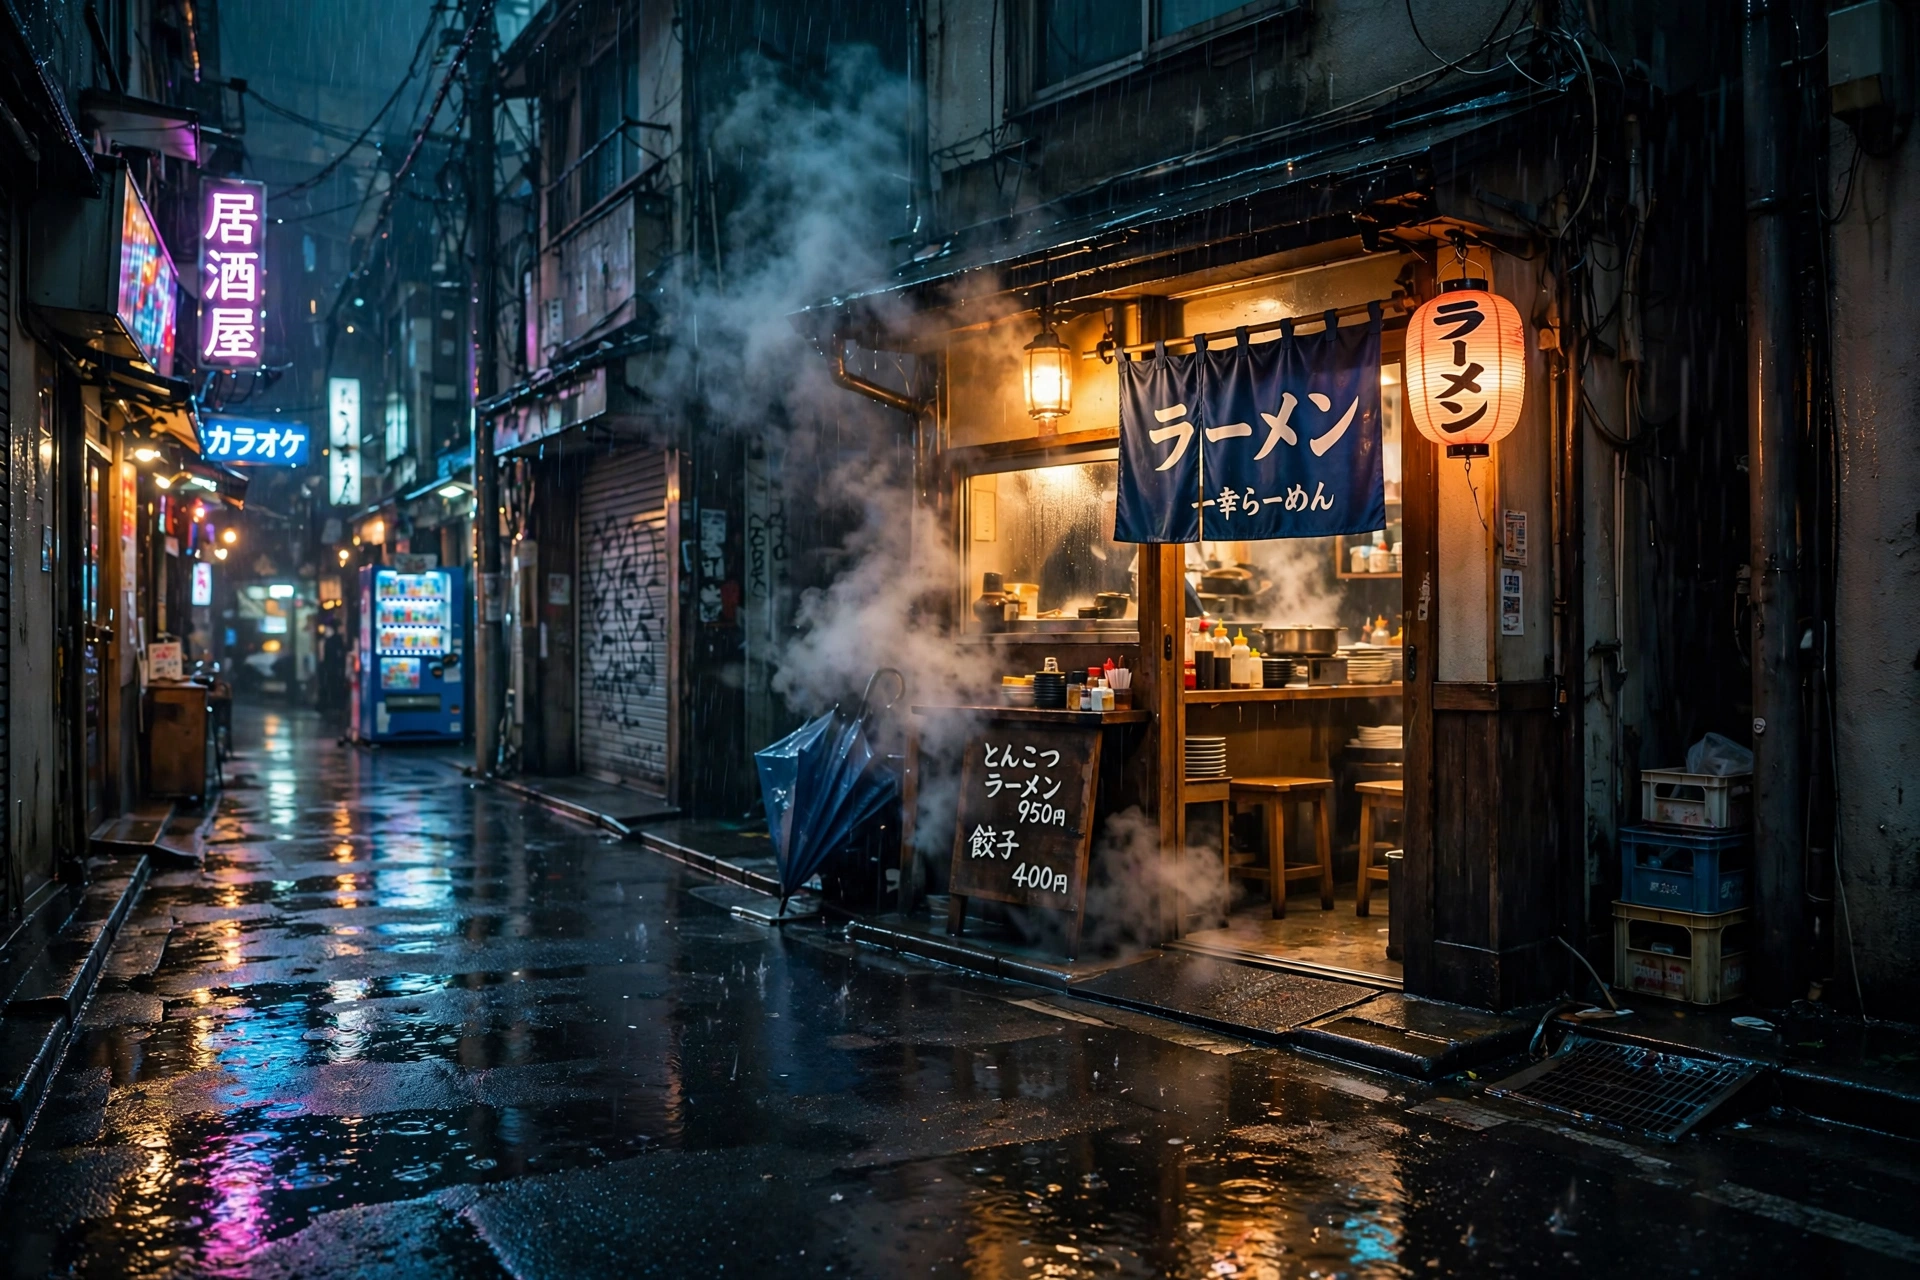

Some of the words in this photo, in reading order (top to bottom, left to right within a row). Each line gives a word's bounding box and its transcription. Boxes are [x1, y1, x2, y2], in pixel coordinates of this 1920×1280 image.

[205, 192, 259, 359] 居酒屋
[1433, 299, 1488, 434] ラーメン
[207, 425, 305, 459] カラオケ
[1149, 391, 1360, 472] ラーメン
[1191, 481, 1335, 521] 一幸らーめん
[983, 742, 1060, 769] とんこつ
[984, 773, 1062, 801] ラーメン
[1018, 799, 1066, 827] 950円
[968, 823, 1020, 860] 餃子
[1011, 862, 1068, 895] 400円
